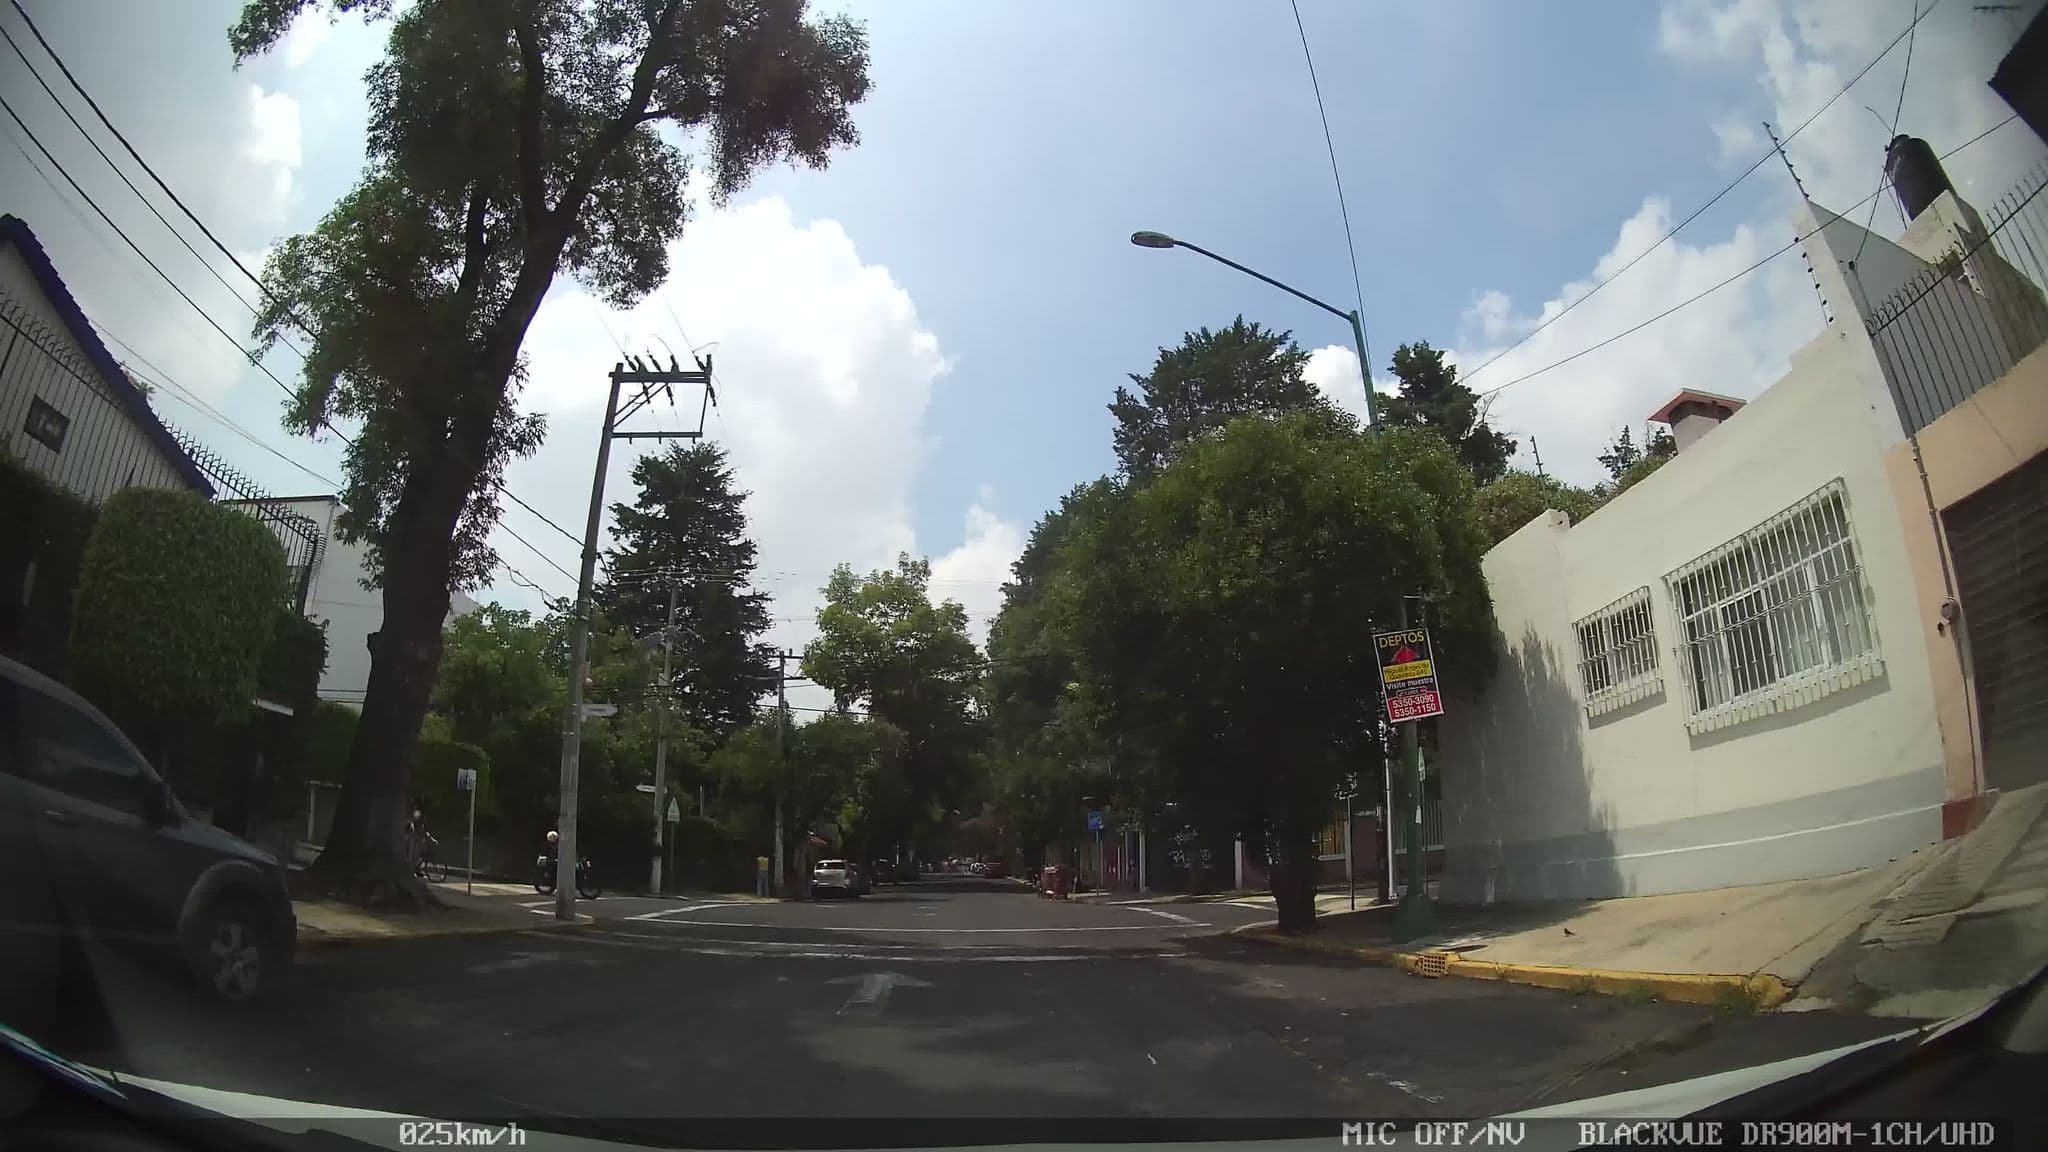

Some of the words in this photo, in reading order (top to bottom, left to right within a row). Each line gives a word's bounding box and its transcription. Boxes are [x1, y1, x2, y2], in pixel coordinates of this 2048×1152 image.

[1379, 631, 1424, 648] DEPTOS
[1386, 682, 1406, 690] Visite
[1407, 677, 1434, 686] muestra
[1392, 694, 1435, 708] 5350-3090
[1394, 703, 1436, 717] 5350-1150
